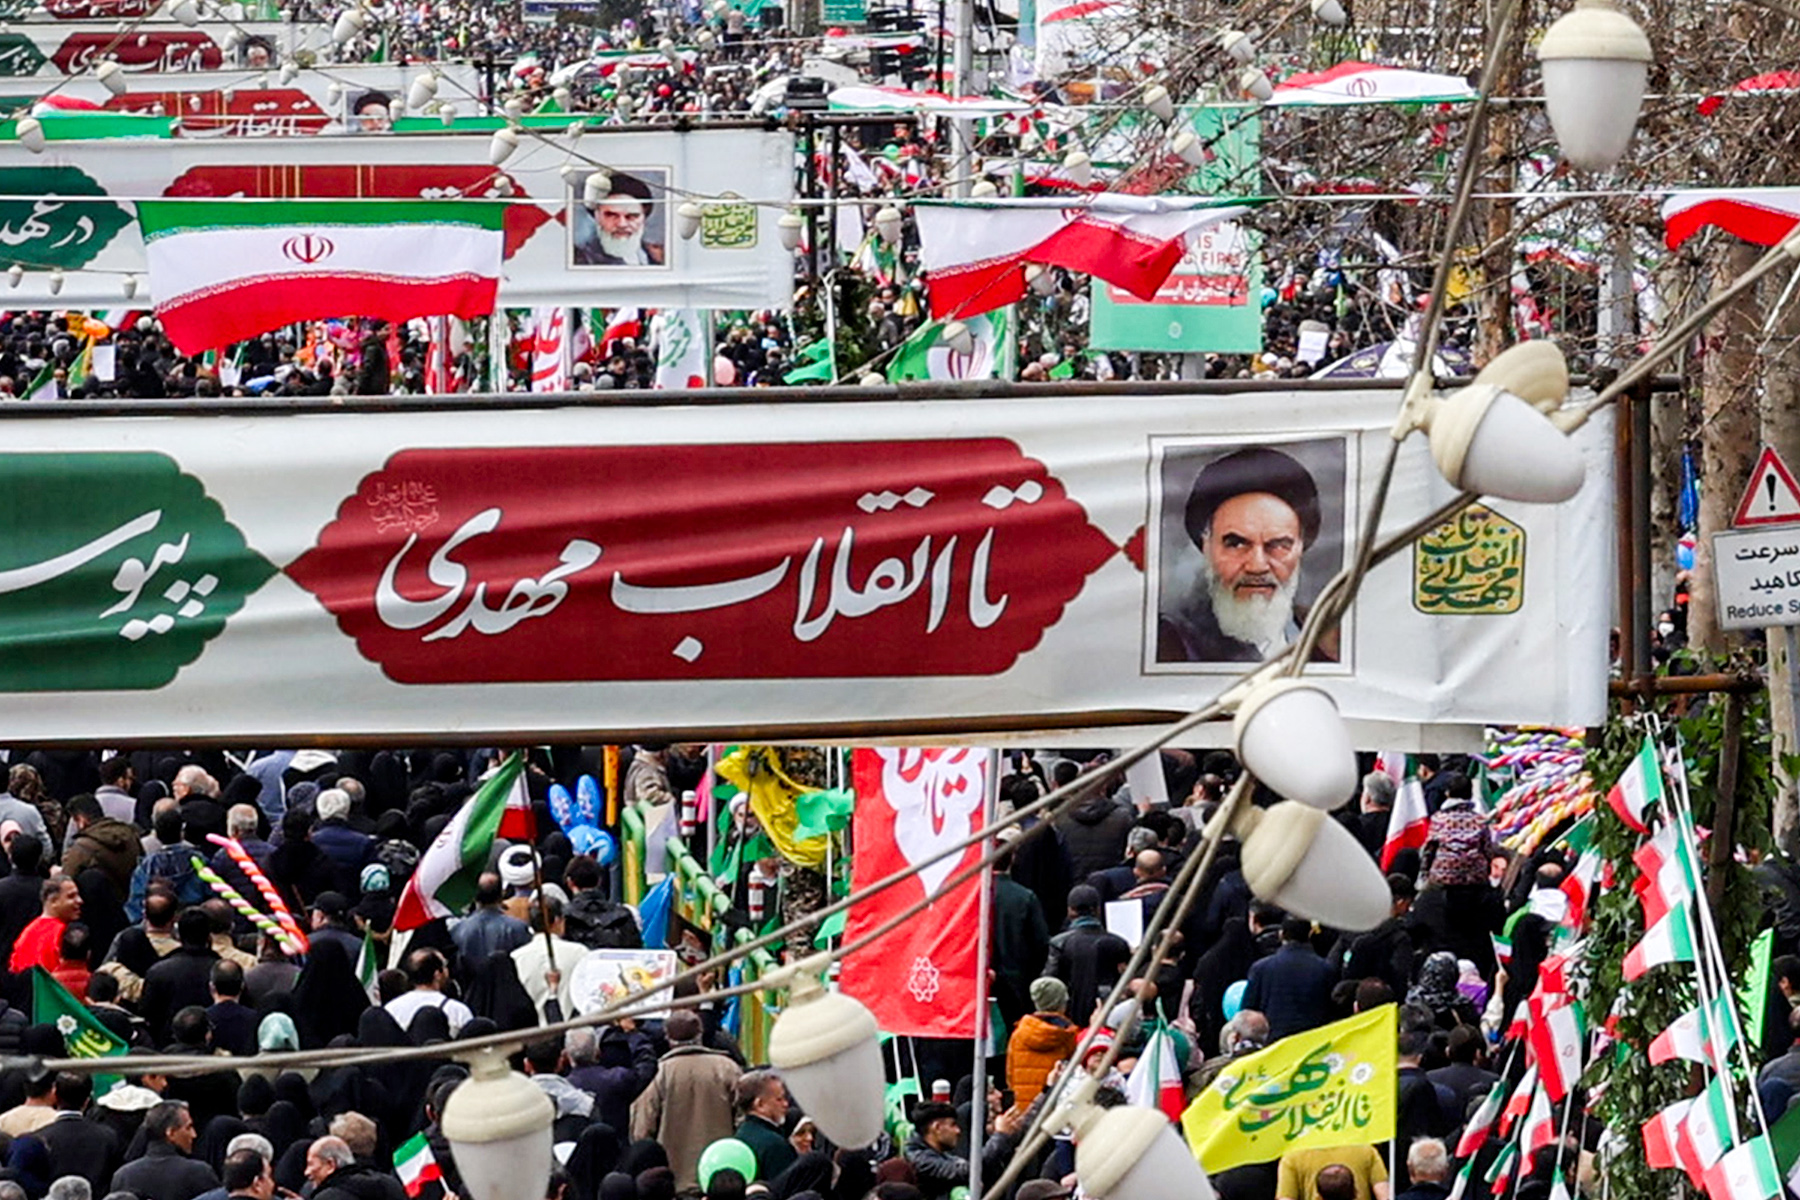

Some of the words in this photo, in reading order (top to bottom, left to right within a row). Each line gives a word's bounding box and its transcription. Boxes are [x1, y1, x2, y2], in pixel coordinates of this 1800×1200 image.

[51, 215, 95, 249] در
[374, 507, 602, 642] مهدی
[610, 487, 957, 662] انقلاب
[968, 481, 1043, 628] تا
[1735, 544, 1799, 564] سرعت
[1727, 603, 1783, 619] Reduce
[1788, 599, 1800, 613] S
